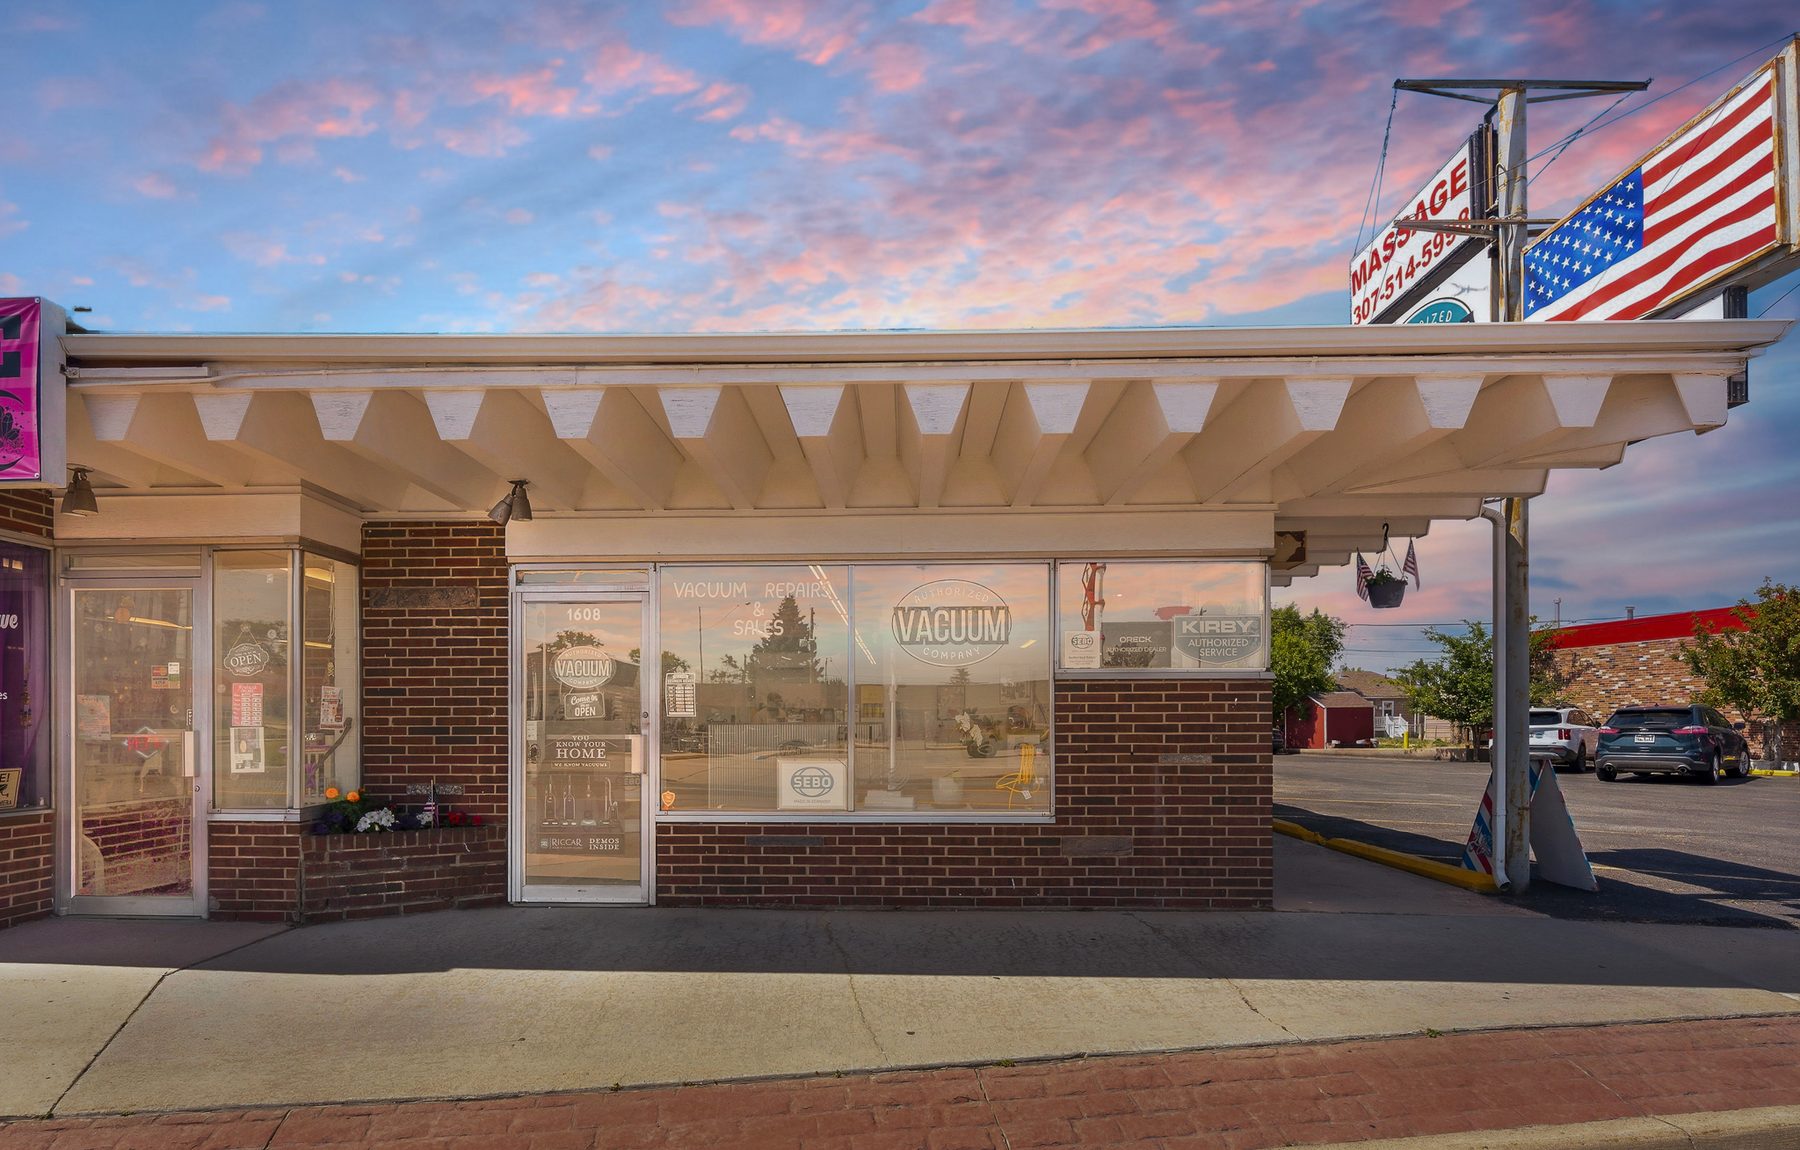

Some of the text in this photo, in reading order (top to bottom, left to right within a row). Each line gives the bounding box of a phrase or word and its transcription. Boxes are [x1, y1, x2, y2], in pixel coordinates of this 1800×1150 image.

[1351, 157, 1468, 297] MASSAGE
[1418, 309, 1453, 323] IZED
[673, 582, 829, 599] VACUUM REPAIRS
[914, 587, 989, 604] AUTHORIZED
[566, 607, 601, 621] 1608
[753, 601, 765, 617] &
[733, 619, 784, 636] SALES
[896, 608, 1006, 642] VACUUM
[1182, 620, 1253, 634] KIRBY
[1187, 638, 1249, 647] AUTHORIZED
[230, 652, 262, 667] OPEN
[923, 647, 981, 660] COMPANY
[1199, 648, 1238, 657] SERVICE
[557, 659, 610, 677] VACUUM
[570, 695, 590, 705] Come
[574, 706, 596, 717] OPEN
[555, 748, 606, 759] HOME
[793, 776, 832, 788] SEBO
[552, 838, 583, 847] RICCAR
